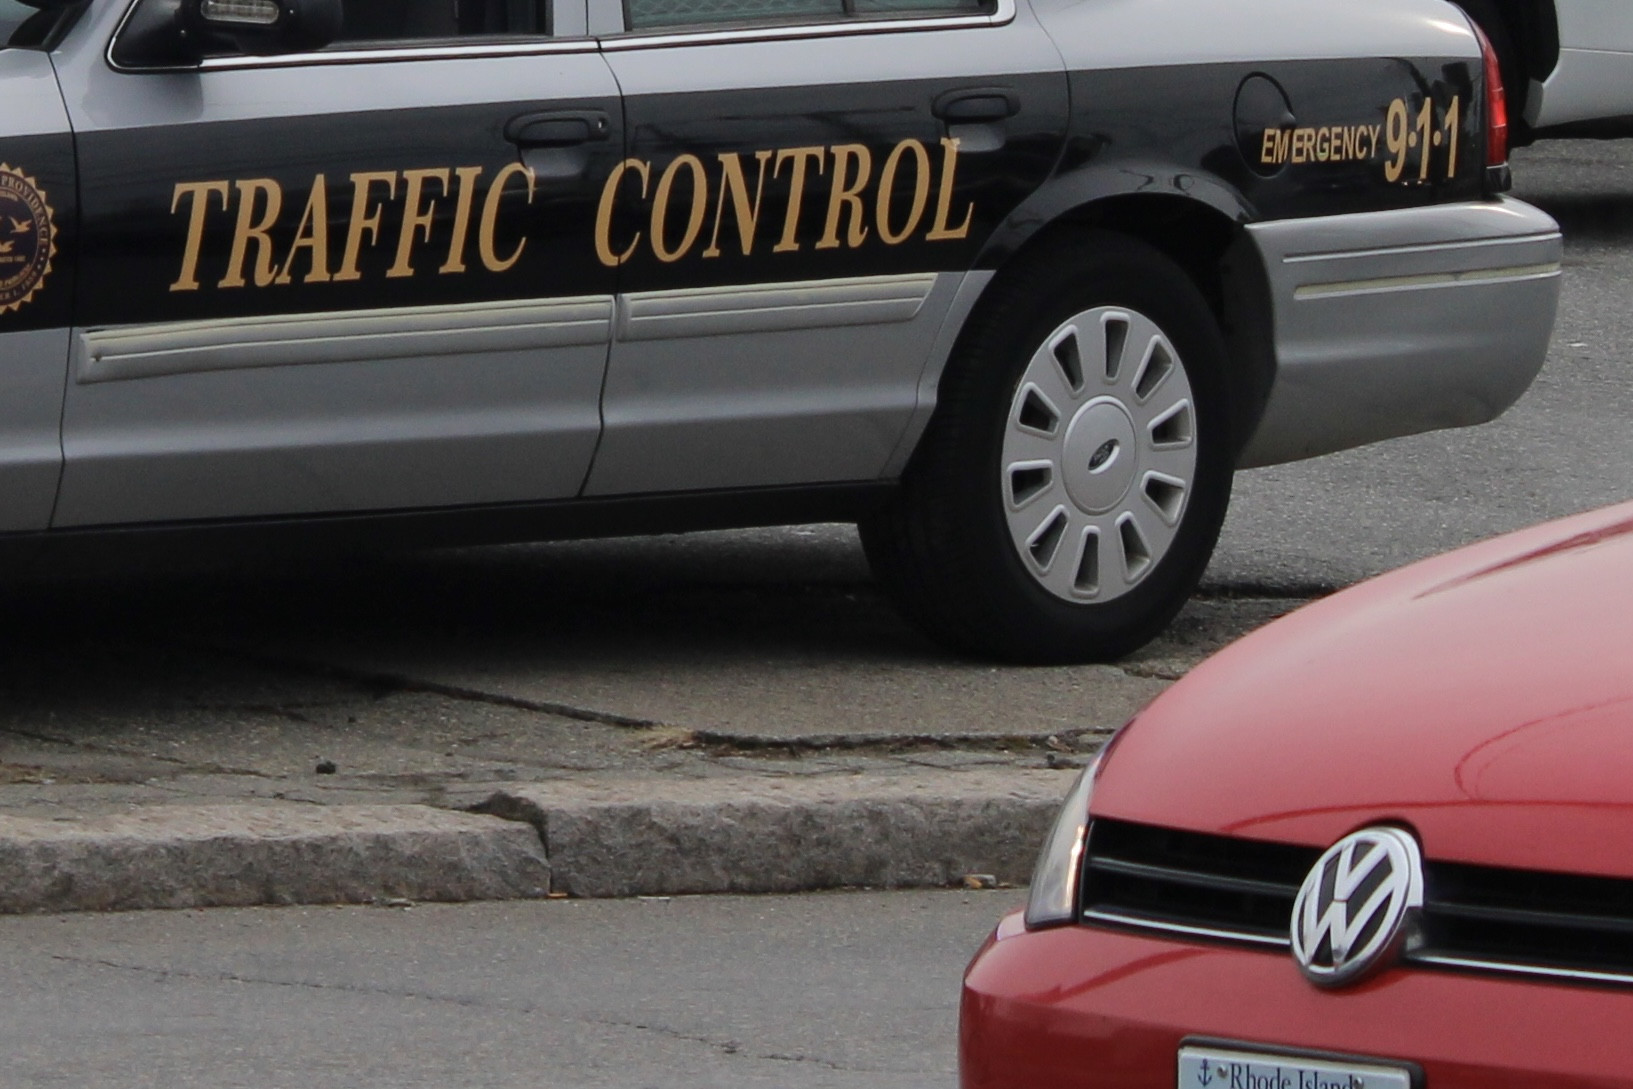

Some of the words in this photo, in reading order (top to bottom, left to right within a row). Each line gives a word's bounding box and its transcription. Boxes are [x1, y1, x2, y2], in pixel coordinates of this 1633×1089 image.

[1261, 124, 1381, 164] EMERGENCY
[1, 174, 49, 243] PROVIDENCE
[169, 162, 535, 291] TRAFFIC
[594, 137, 974, 266] CONTROL
[1229, 1063, 1292, 1089] Rhode
